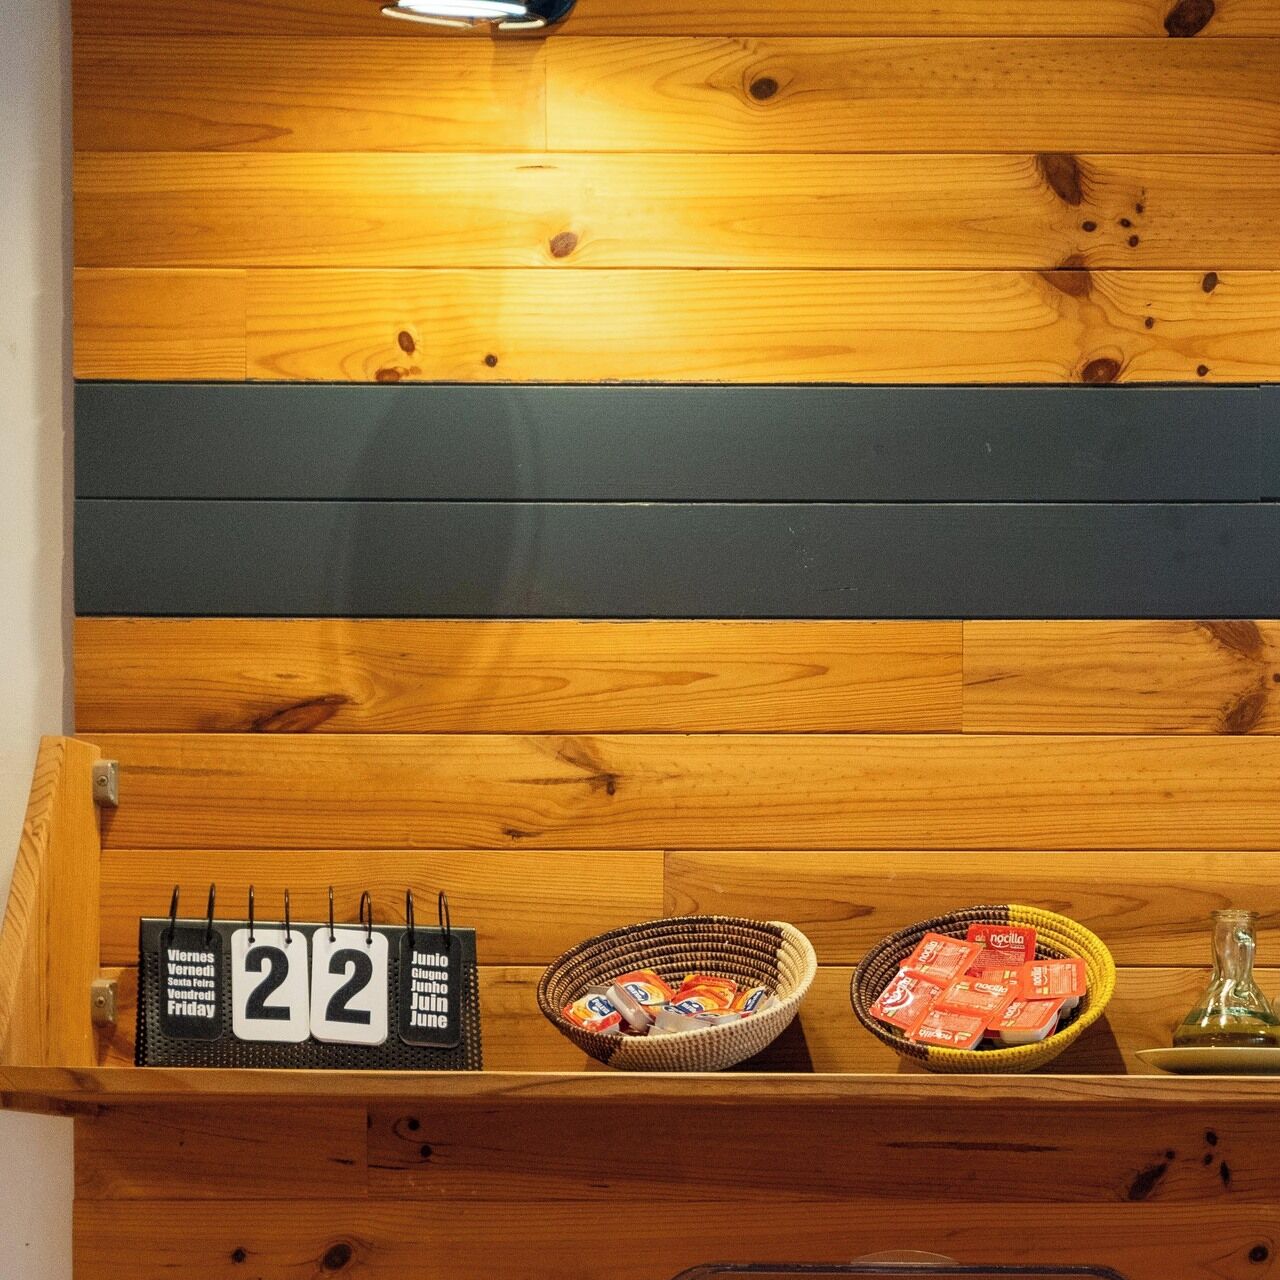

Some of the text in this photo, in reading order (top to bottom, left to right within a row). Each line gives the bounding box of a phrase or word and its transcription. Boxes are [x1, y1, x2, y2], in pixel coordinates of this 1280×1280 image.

[990, 931, 1024, 945] nocilla
[167, 949, 215, 963] Viernes
[411, 951, 448, 968] Junio
[411, 968, 448, 980] Giugno
[168, 977, 215, 988] Sexta Feira
[244, 945, 374, 1025] 2 2
[410, 980, 448, 994] Junho
[168, 988, 216, 1000] Vendredi
[168, 1000, 216, 1018] Friday
[410, 992, 448, 1012] Juin
[410, 1010, 448, 1028] June
